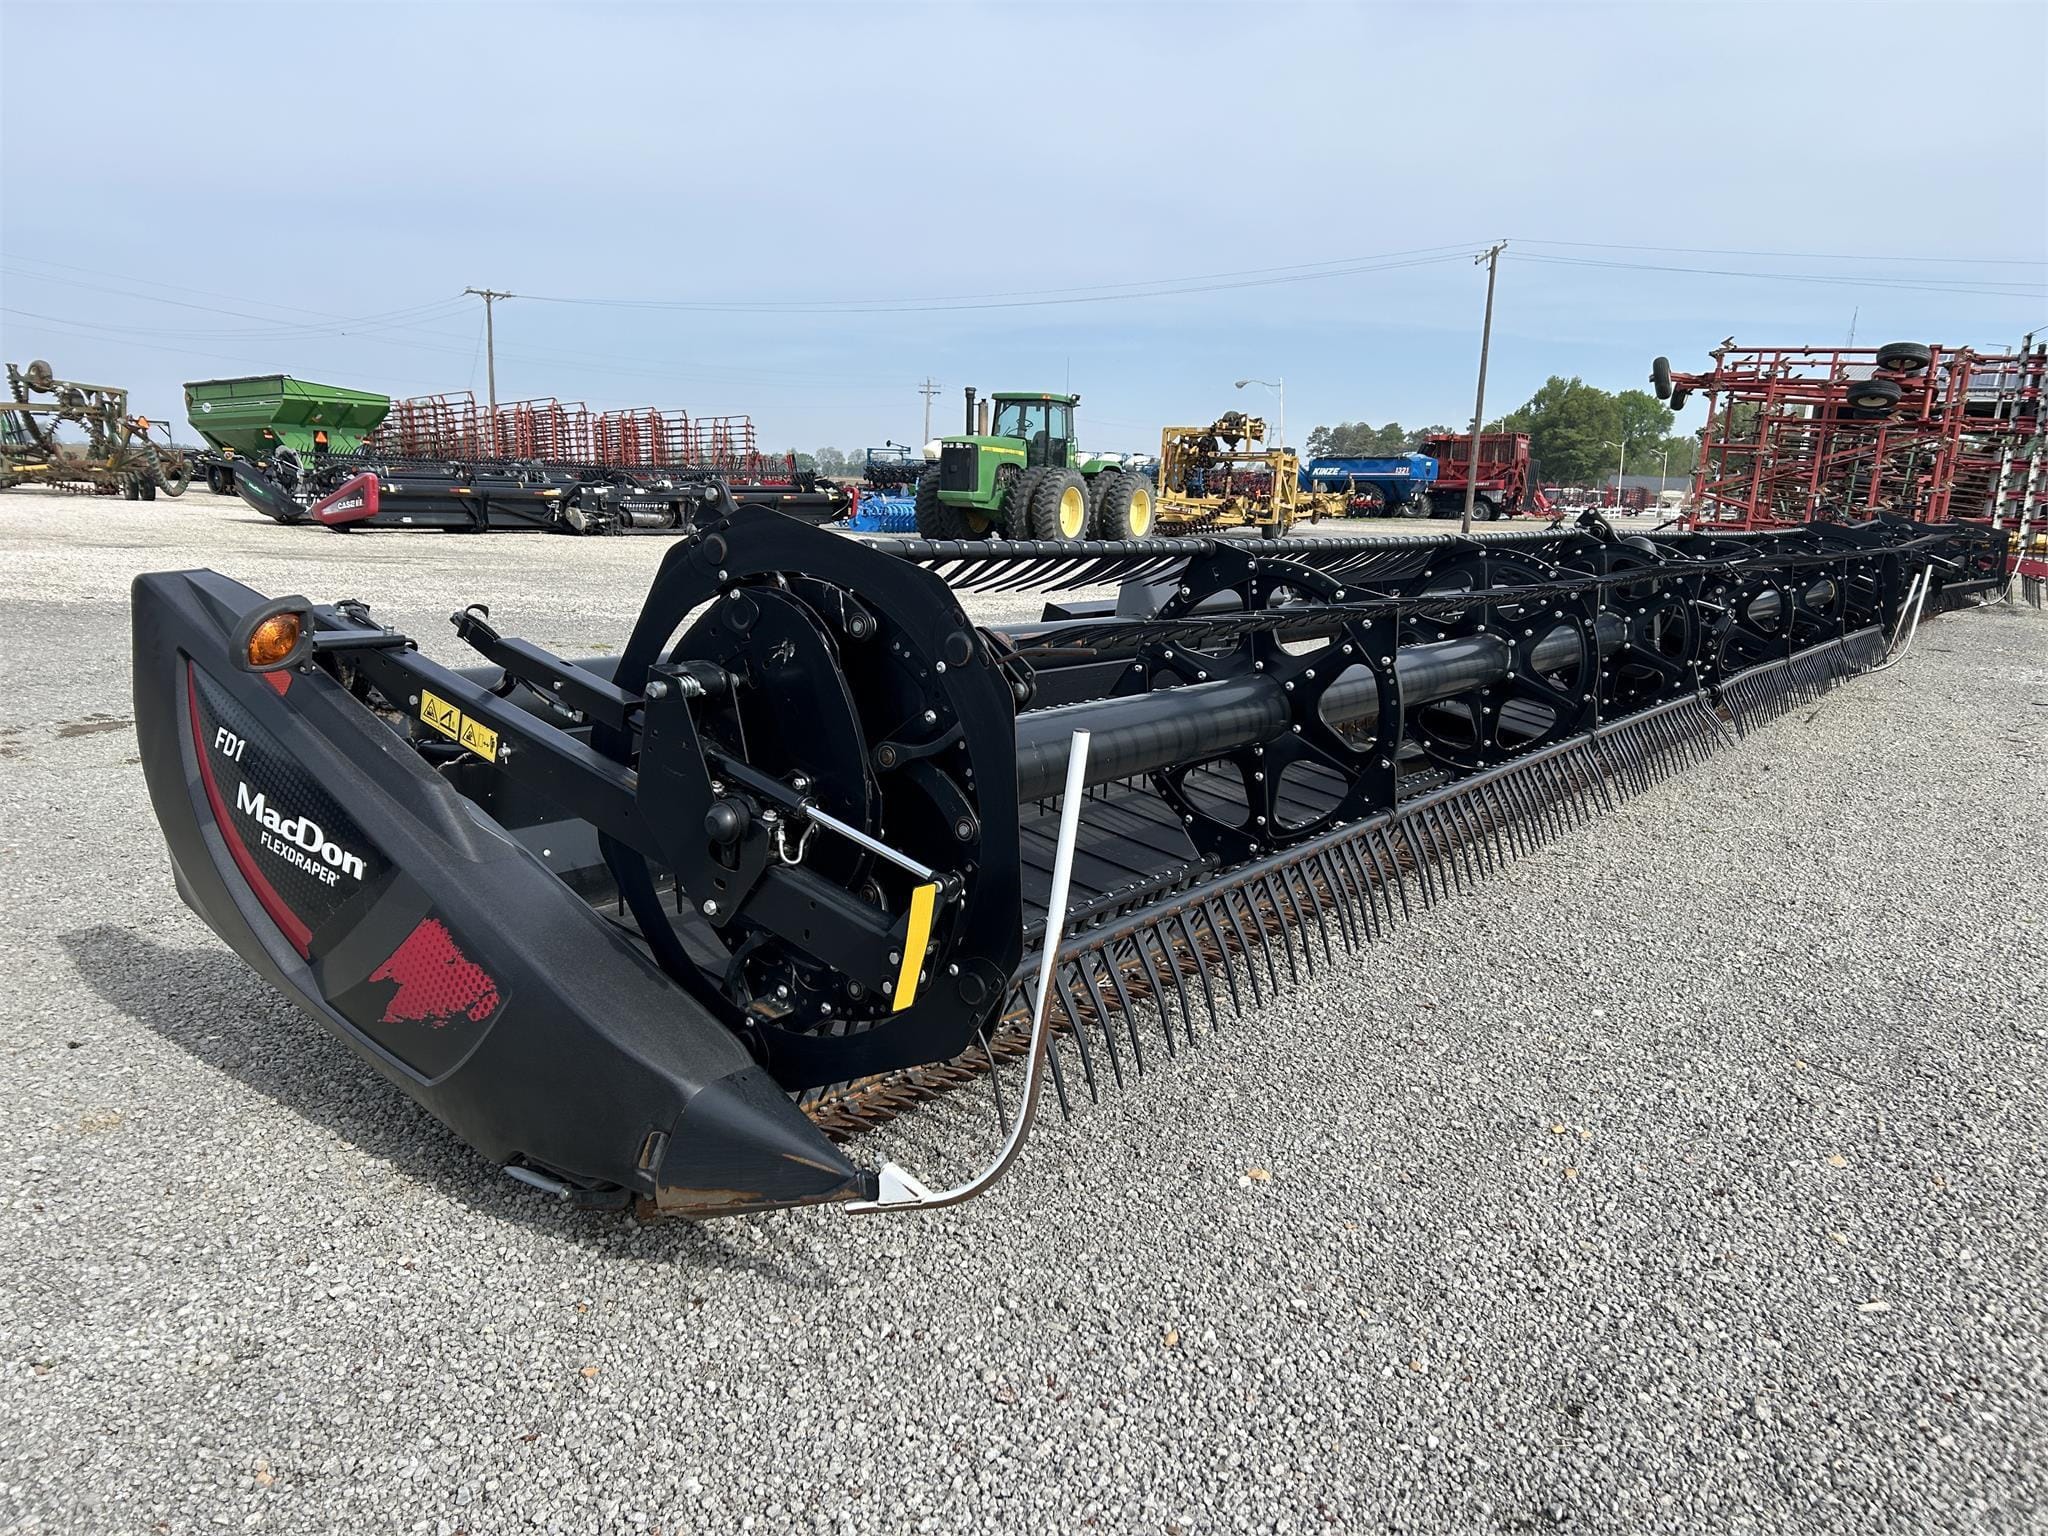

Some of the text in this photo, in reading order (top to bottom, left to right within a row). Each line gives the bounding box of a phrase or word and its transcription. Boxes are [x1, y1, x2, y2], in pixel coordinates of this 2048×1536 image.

[1312, 467, 1340, 475] KINZE
[337, 500, 355, 509] CASE
[214, 726, 246, 762] FD1
[236, 781, 365, 881] MacDon
[260, 831, 337, 887] FLEXDRAPER
